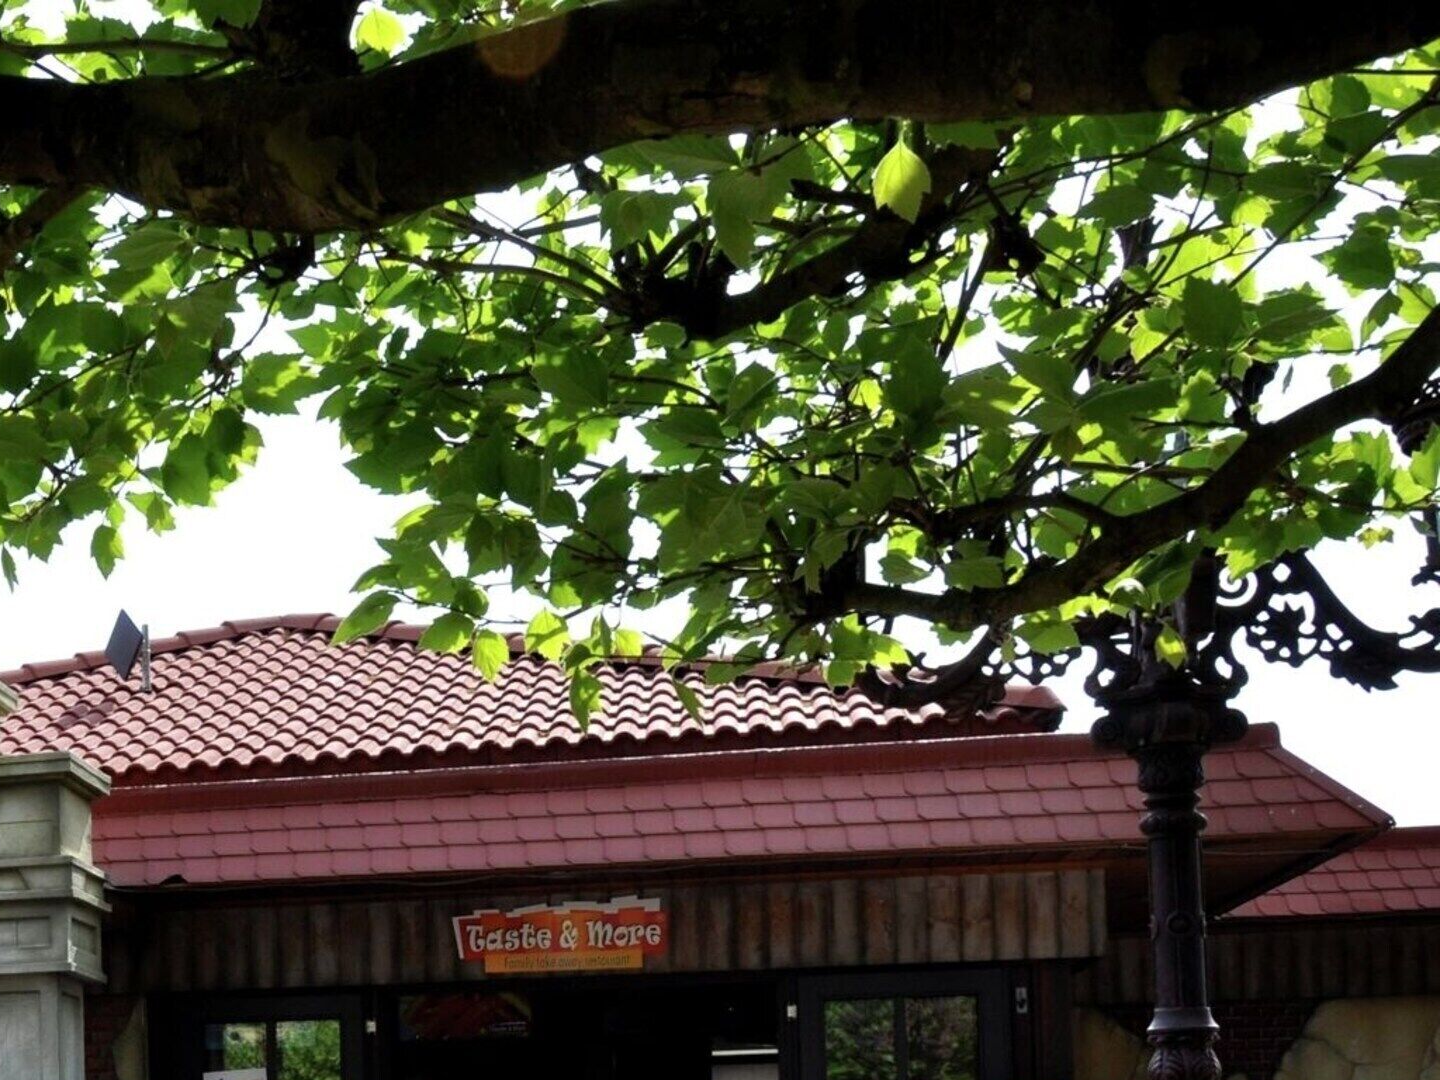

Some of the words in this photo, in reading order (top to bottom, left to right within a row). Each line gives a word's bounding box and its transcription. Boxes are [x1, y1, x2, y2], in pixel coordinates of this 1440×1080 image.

[466, 923, 552, 951] Taste
[560, 920, 578, 950] &
[586, 921, 661, 948] More
[536, 955, 556, 968] take
